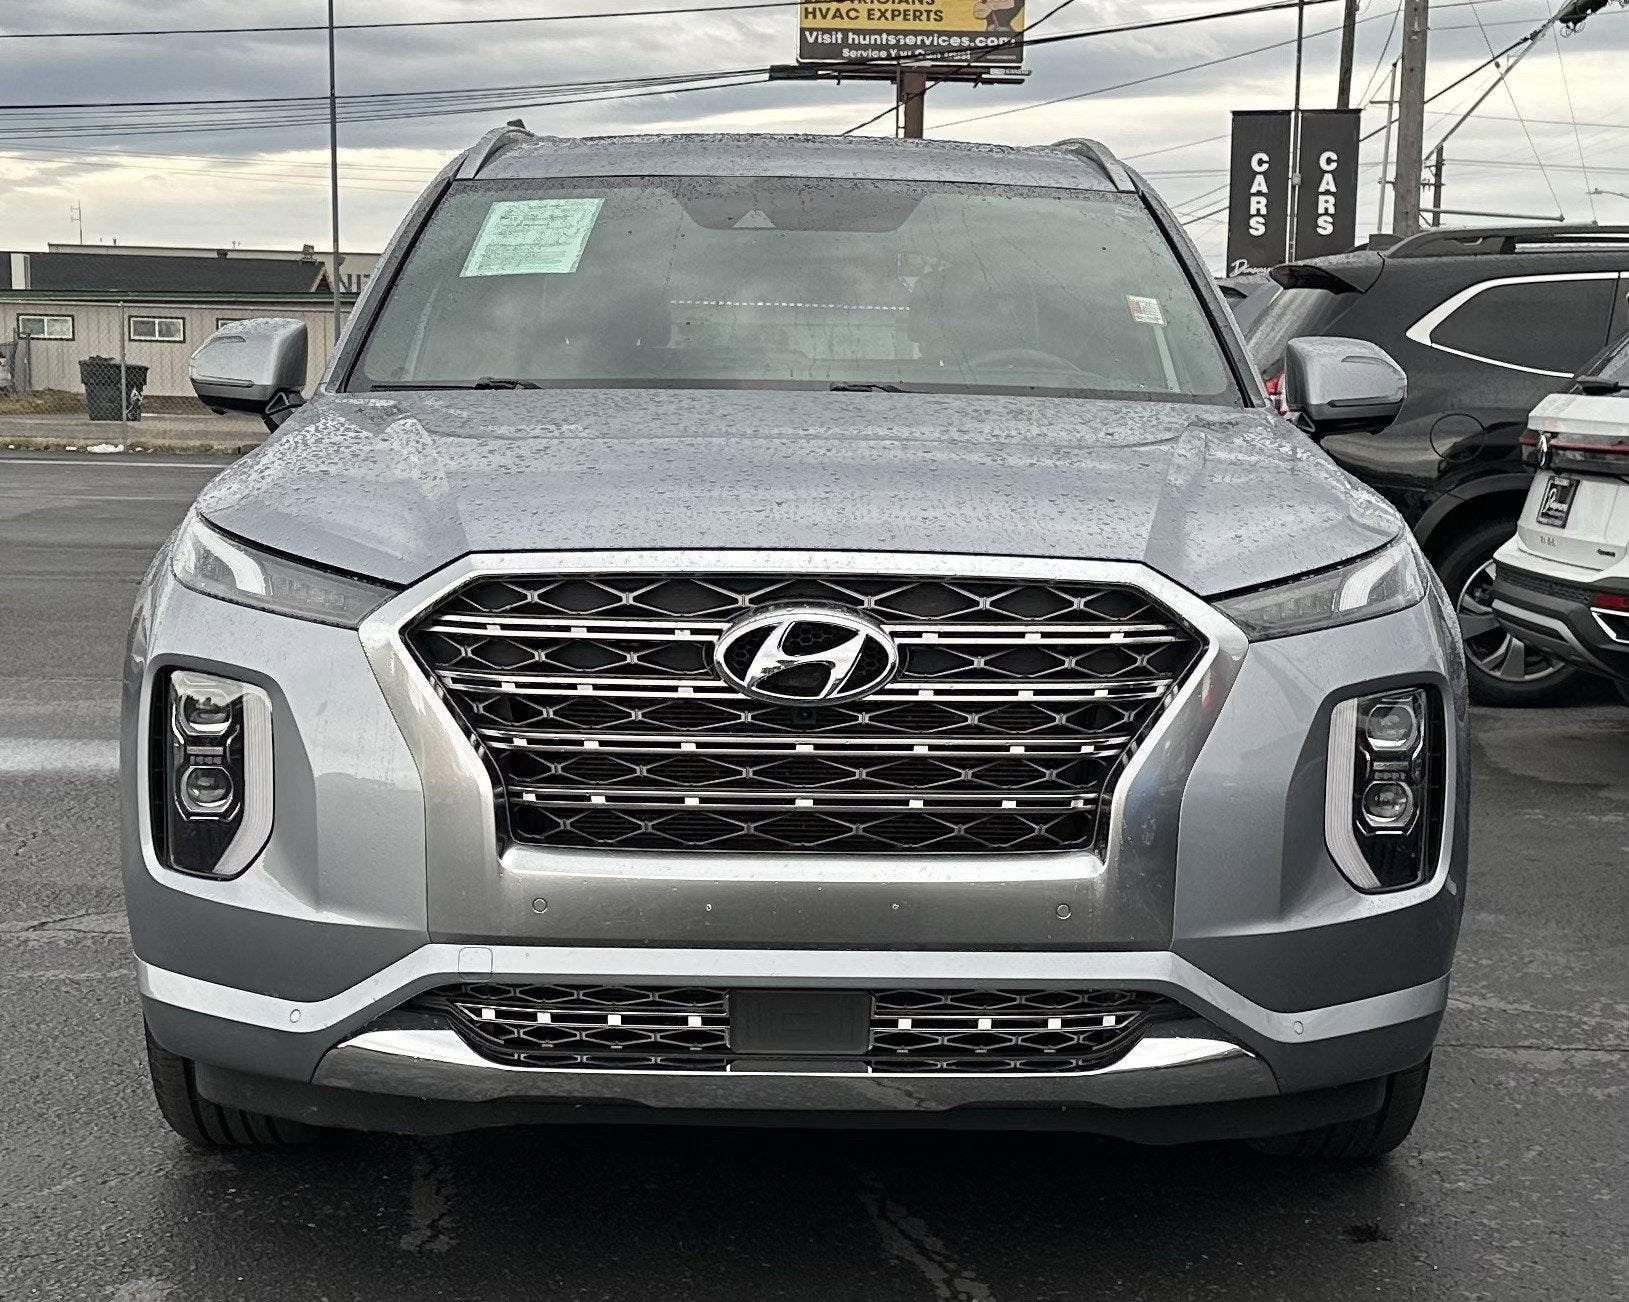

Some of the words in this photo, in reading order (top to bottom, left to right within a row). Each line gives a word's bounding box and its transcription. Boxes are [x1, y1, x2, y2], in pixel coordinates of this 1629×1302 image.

[804, 7, 860, 20] HVAC
[867, 8, 944, 22] EXPERTS
[804, 31, 843, 44] Visit
[842, 48, 888, 58] Service
[889, 49, 912, 58] Yur
[1249, 152, 1270, 236] CARS
[1316, 151, 1338, 235] CARS
